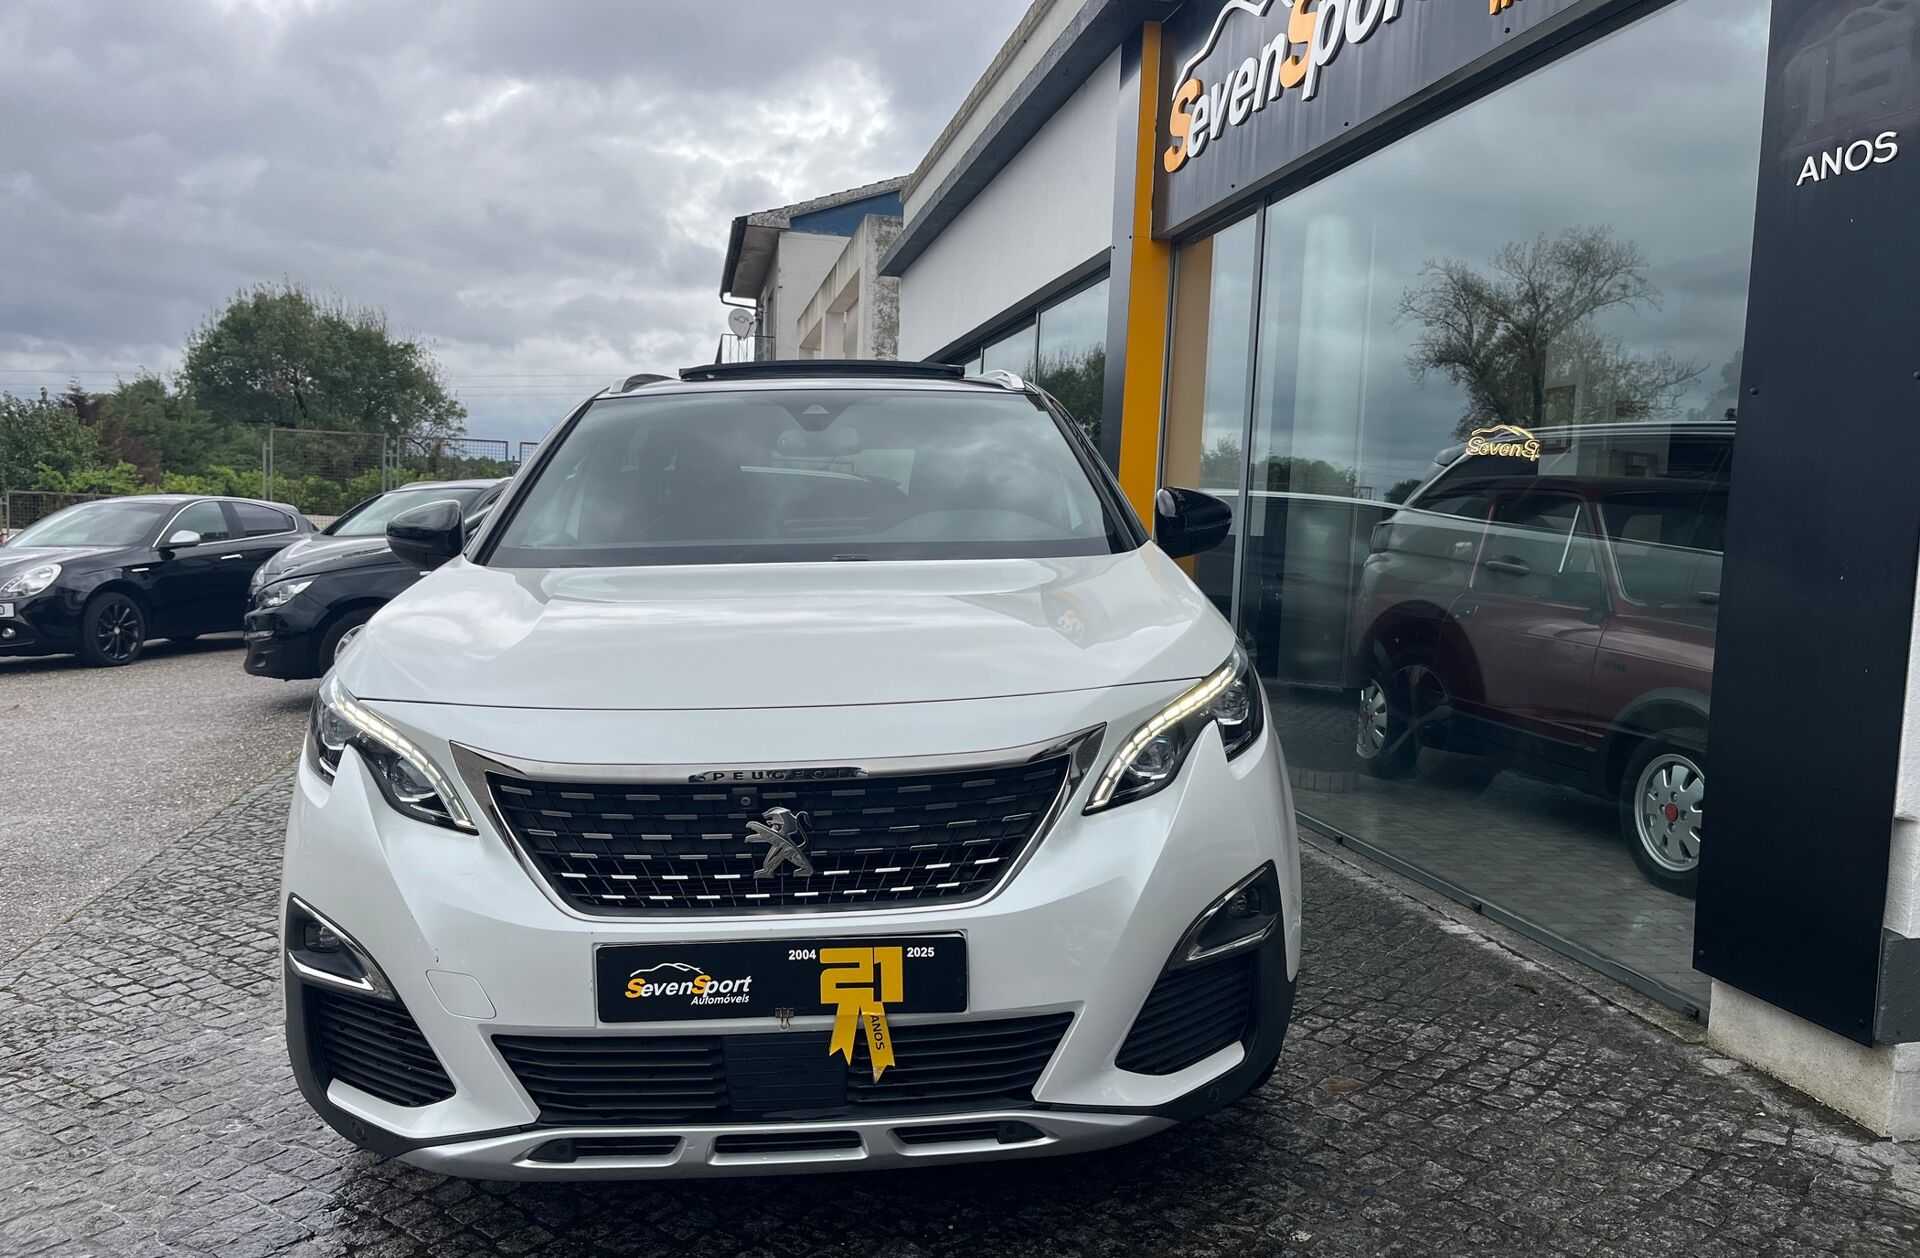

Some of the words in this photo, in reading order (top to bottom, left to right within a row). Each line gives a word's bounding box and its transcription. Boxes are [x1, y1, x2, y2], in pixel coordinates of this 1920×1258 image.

[1796, 131, 1898, 186] ANOS
[713, 767, 846, 781] PEUGEOT
[624, 975, 752, 999] SevenSport
[788, 949, 816, 960] 2004
[819, 946, 904, 1004] 21
[906, 947, 935, 958] 2025
[690, 994, 750, 1006] Automóveis
[870, 1015, 885, 1051] ANOS
